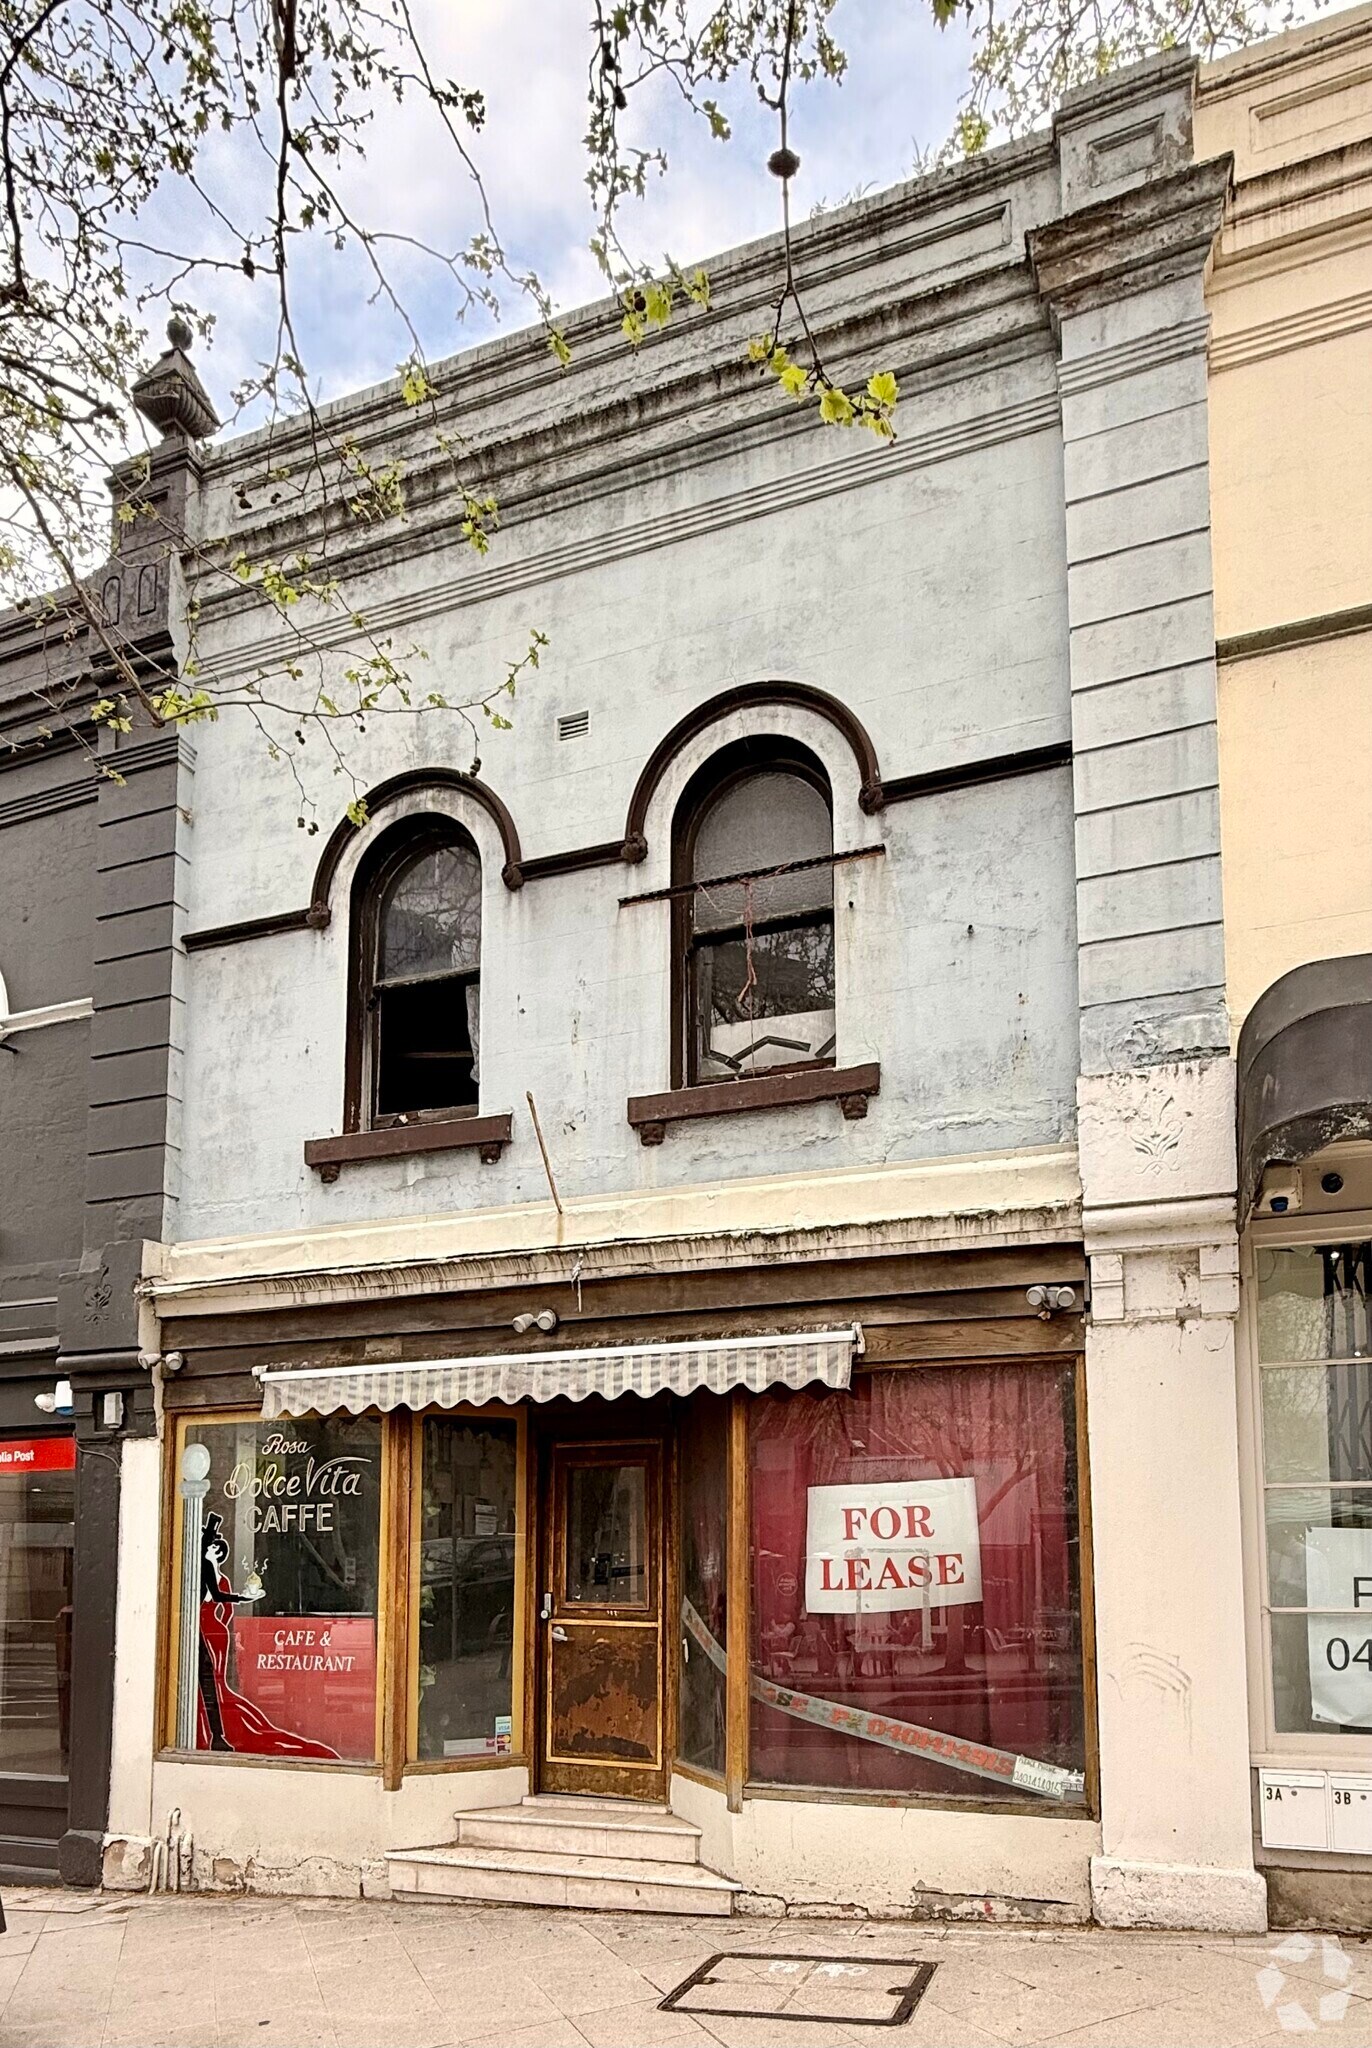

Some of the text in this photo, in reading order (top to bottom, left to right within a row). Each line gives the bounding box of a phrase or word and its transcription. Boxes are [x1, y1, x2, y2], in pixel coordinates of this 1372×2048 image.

[262, 1433, 316, 1455] Rosa
[0, 1449, 35, 1462] lia Post
[223, 1463, 301, 1499] Dolce
[306, 1456, 372, 1497] Vita
[245, 1503, 334, 1534] CAFFE
[841, 1505, 935, 1540] FOR
[820, 1553, 965, 1590] LEASE
[274, 1630, 331, 1646] CAFE &
[257, 1654, 355, 1672] RESTAURANT
[1326, 1637, 1372, 1671] 04
[1266, 1787, 1282, 1801] 3A
[1335, 1791, 1351, 1805] 3B
